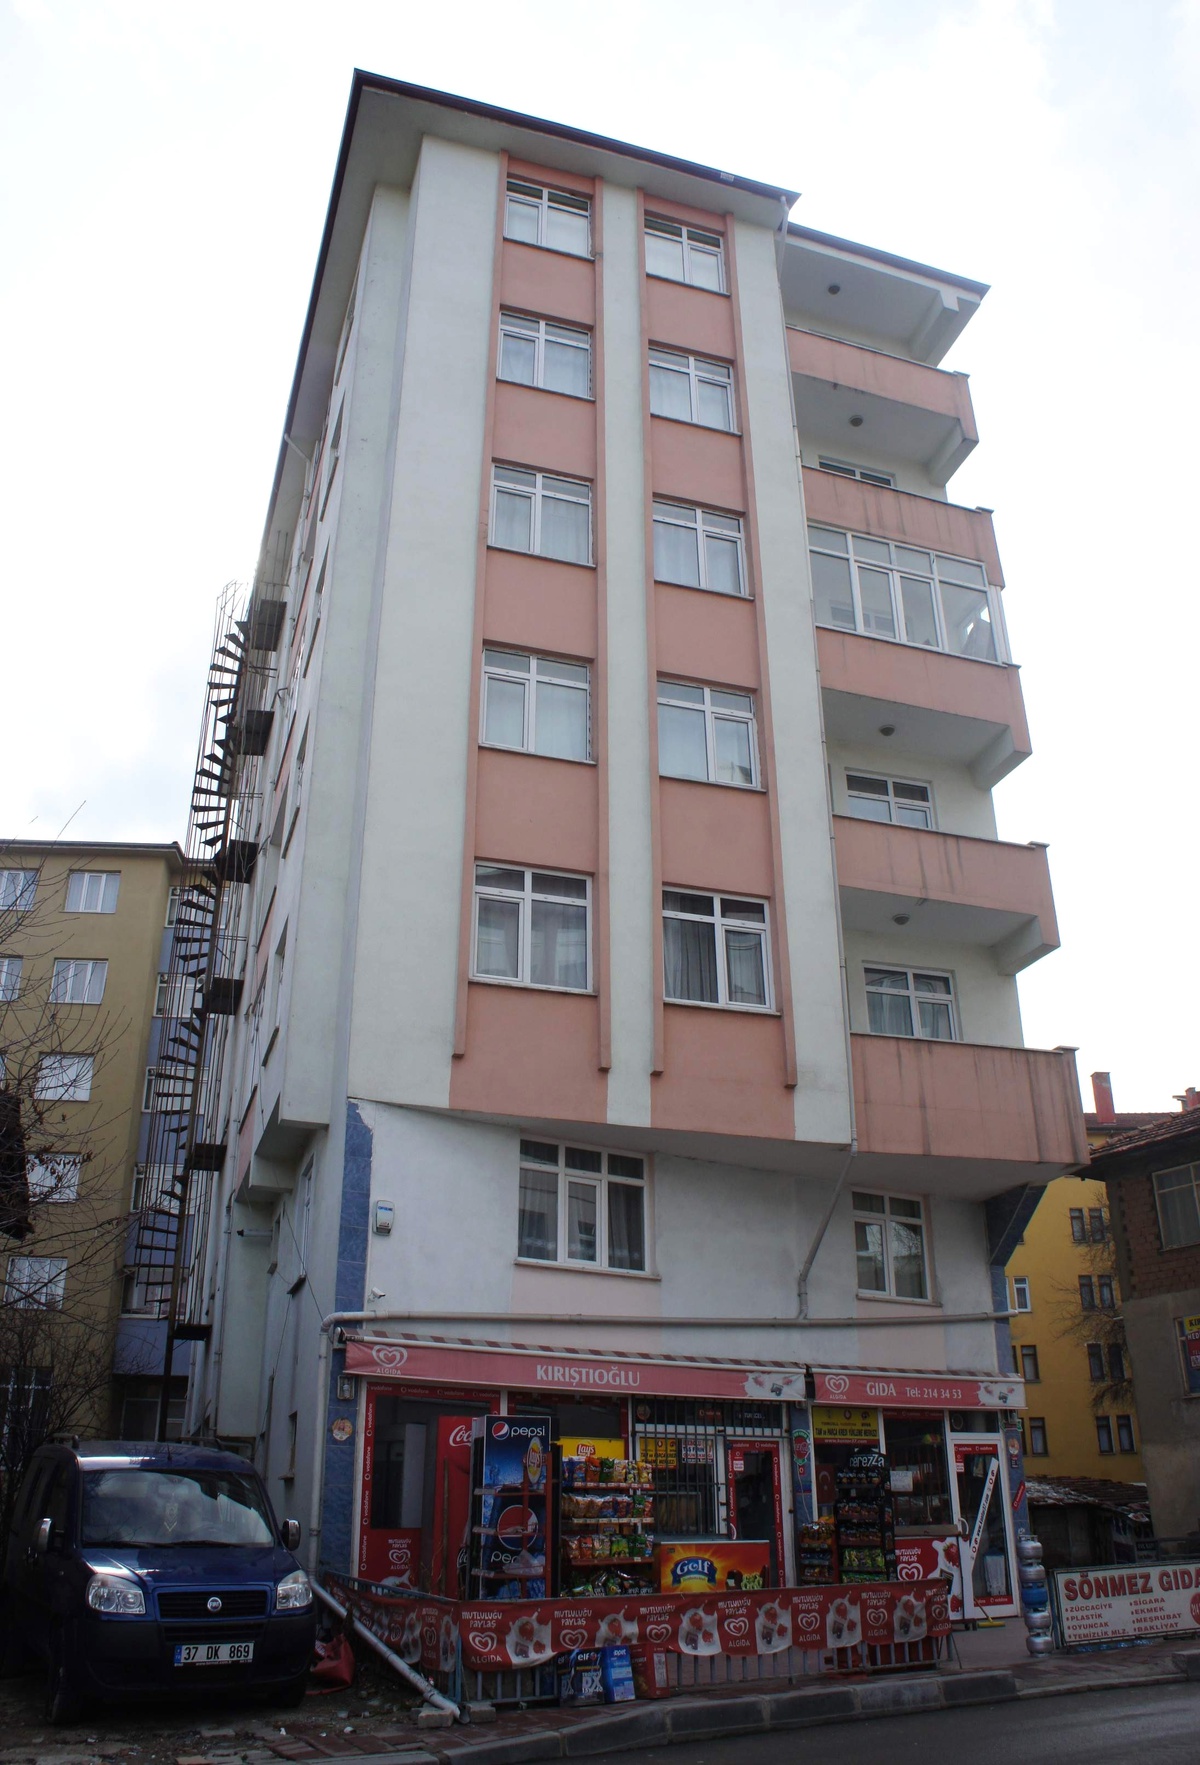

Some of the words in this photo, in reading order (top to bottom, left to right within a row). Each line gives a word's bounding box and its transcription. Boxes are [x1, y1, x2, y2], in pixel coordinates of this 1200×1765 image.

[376, 1367, 402, 1375] ALGIDA
[536, 1364, 640, 1386] KIRIŞTIOĞLU
[866, 1381, 896, 1396] GIDA
[905, 1387, 921, 1398] Tel:
[923, 1388, 938, 1398] 214
[940, 1388, 950, 1398] 34
[952, 1389, 962, 1399] 53
[510, 1426, 546, 1438] pepsi
[676, 1559, 711, 1575] Golf
[1063, 1571, 1153, 1601] SÖNMEZ
[1133, 1597, 1166, 1606] SİGARA
[640, 1603, 676, 1614] MUTLULUĞU
[1069, 1602, 1113, 1613] ZÜCCACİYE
[1134, 1606, 1165, 1615] EKMEK
[461, 1610, 503, 1620] MUTLULUĞU
[554, 1608, 593, 1618] MUTLULUĞU
[646, 1612, 670, 1622] PAYLAŞ
[1070, 1613, 1103, 1621] PLASTİK
[1135, 1612, 1182, 1624] MEŞRUBAT
[469, 1619, 497, 1628] PAYLAŞ
[561, 1618, 586, 1627] PAYLAŞ
[1071, 1621, 1110, 1631] OYUNCAK
[1137, 1621, 1180, 1632] BAKLİYAT
[798, 1634, 821, 1642] ALGIDA
[867, 1629, 888, 1637] ALGIDA
[1072, 1630, 1110, 1639] TEMİZLİK
[1111, 1628, 1129, 1636] MLZ.
[728, 1638, 751, 1647] ALGIDA
[184, 1646, 199, 1660] 37
[206, 1645, 221, 1660] DK
[229, 1644, 250, 1659] 869
[577, 1652, 590, 1661] elf
[470, 1655, 503, 1664] ALGIDA
